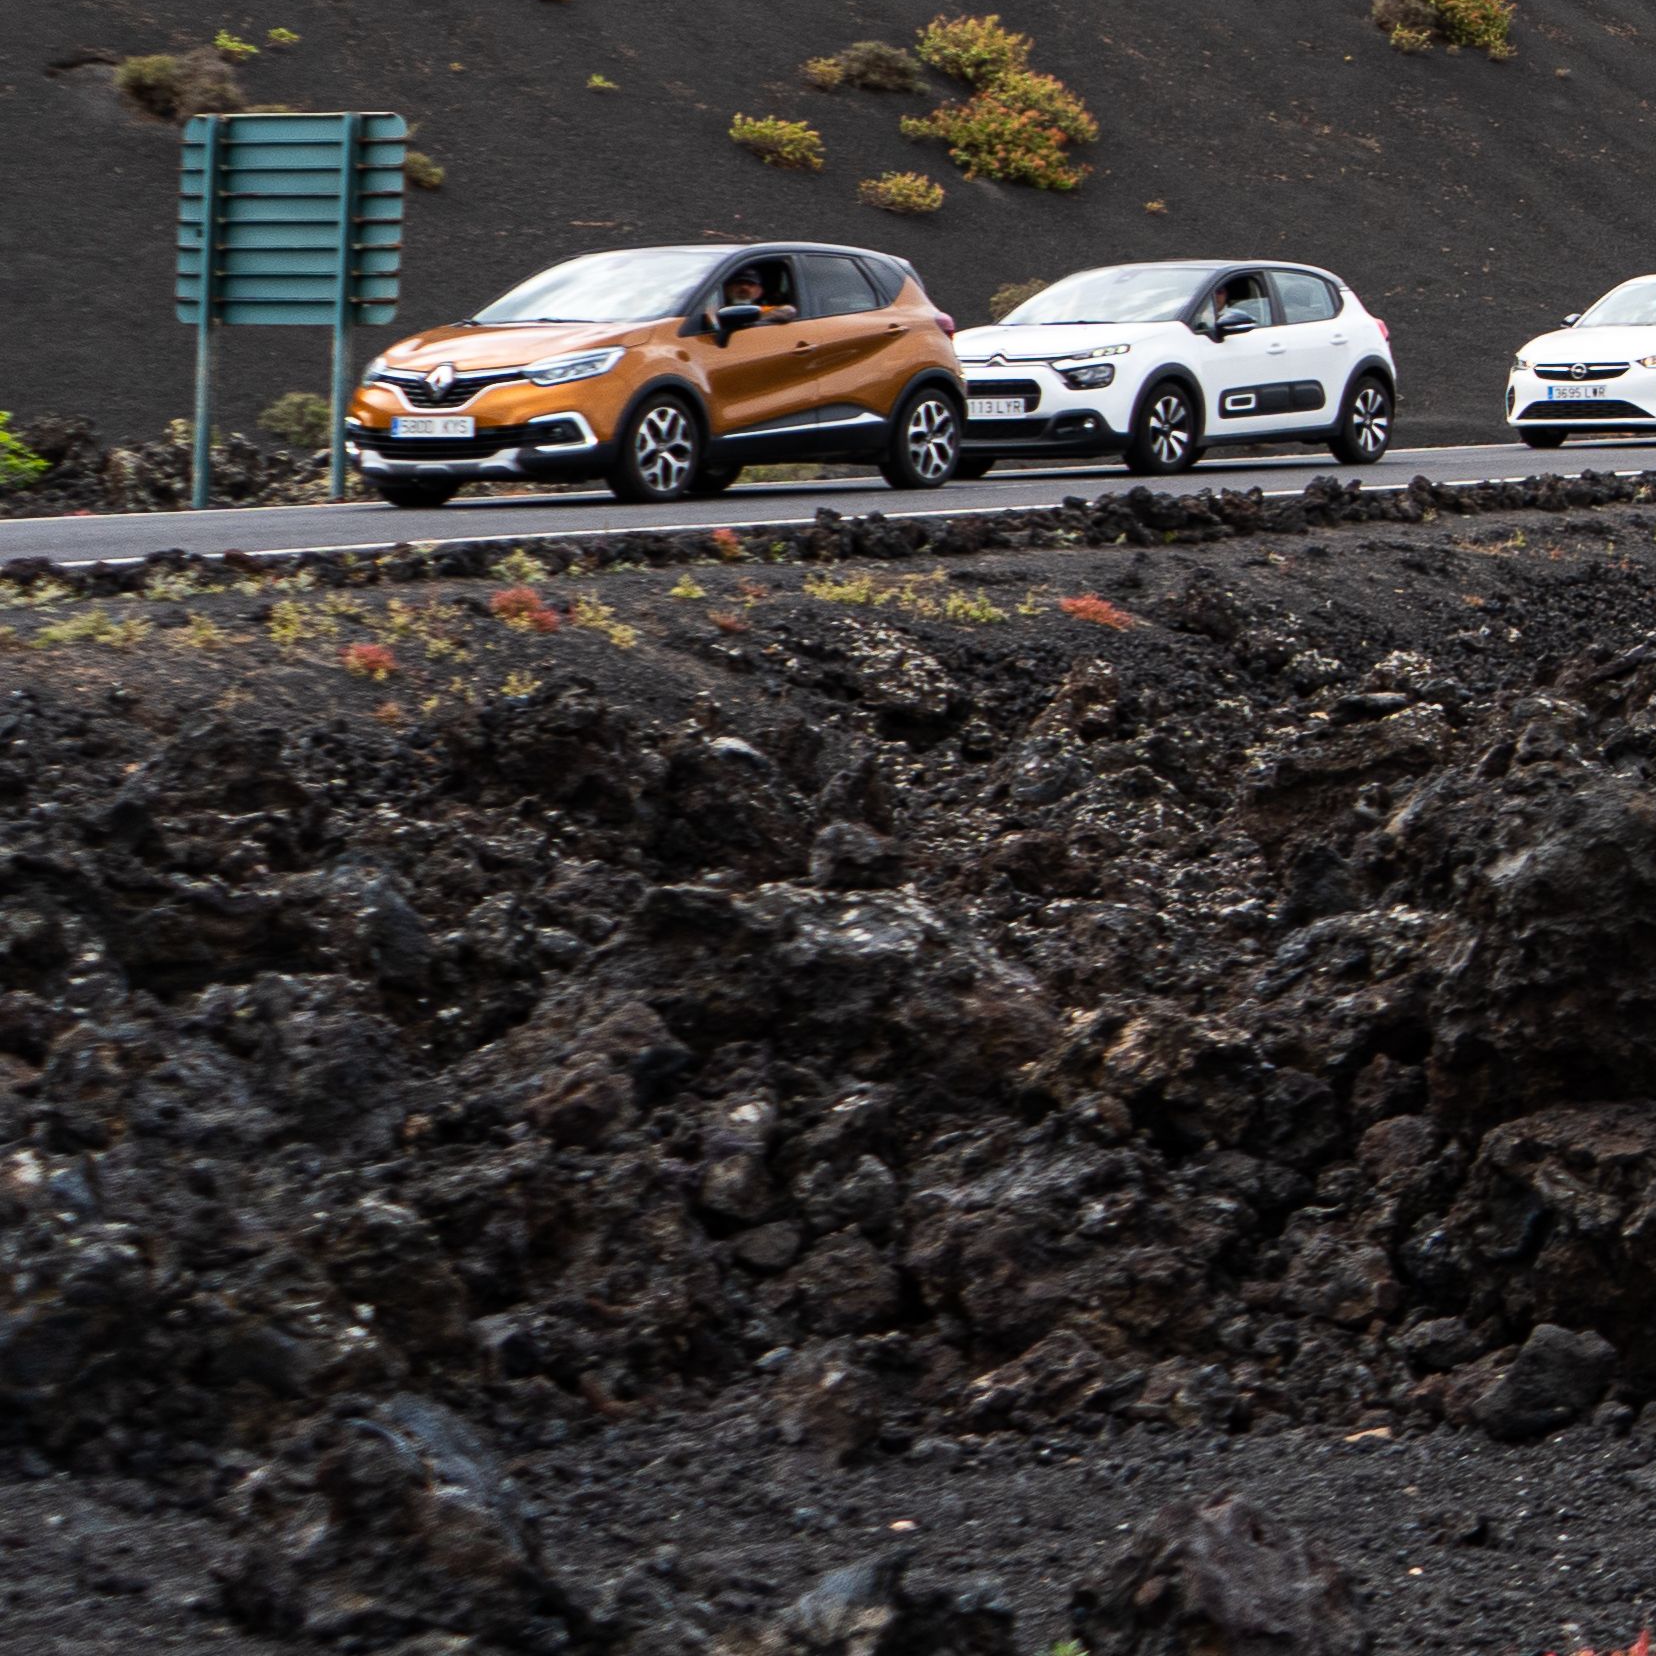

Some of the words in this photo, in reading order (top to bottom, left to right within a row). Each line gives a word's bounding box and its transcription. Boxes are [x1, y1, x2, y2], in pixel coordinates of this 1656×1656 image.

[1555, 387, 1582, 399] 3695
[969, 401, 993, 414] 113
[996, 400, 1021, 414] LYR
